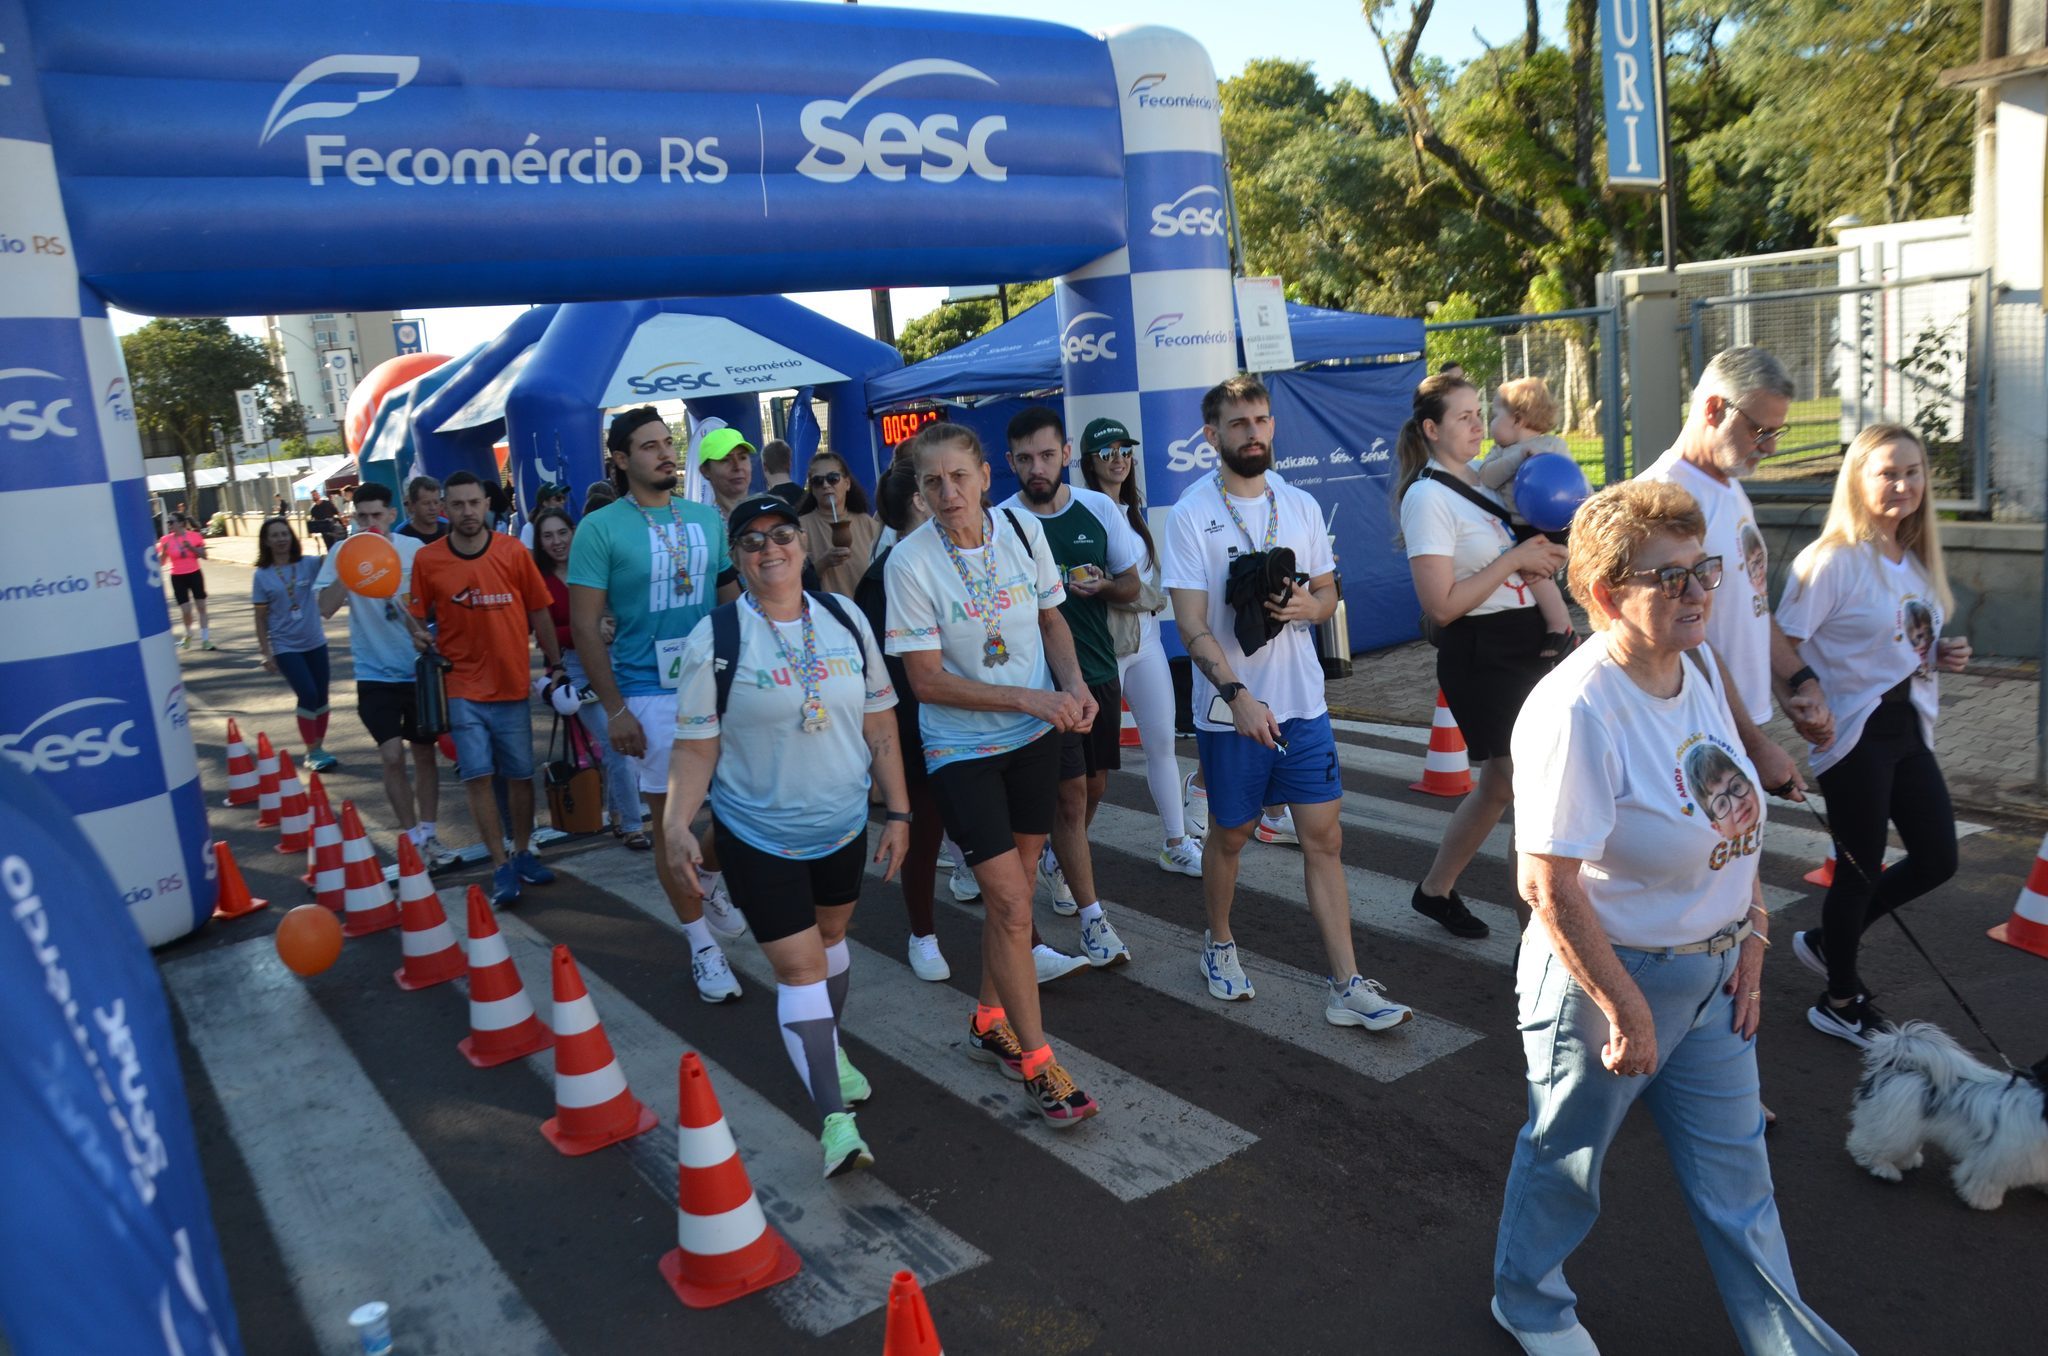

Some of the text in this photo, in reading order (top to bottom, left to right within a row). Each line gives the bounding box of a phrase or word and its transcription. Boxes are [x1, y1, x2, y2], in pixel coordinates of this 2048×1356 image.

[796, 98, 1008, 183] Sesc
[306, 133, 729, 187] Fecomércio RS
[33, 234, 66, 256] RS
[1155, 331, 1226, 348] Fecomércio
[725, 358, 803, 376] Fecomércio
[1166, 439, 1222, 472] Se
[1275, 455, 1318, 470] ndicatos
[0, 569, 123, 601] mércio RS
[1674, 768, 1688, 798] AMOR
[1708, 821, 1761, 871] GAEL
[157, 873, 183, 896] RS
